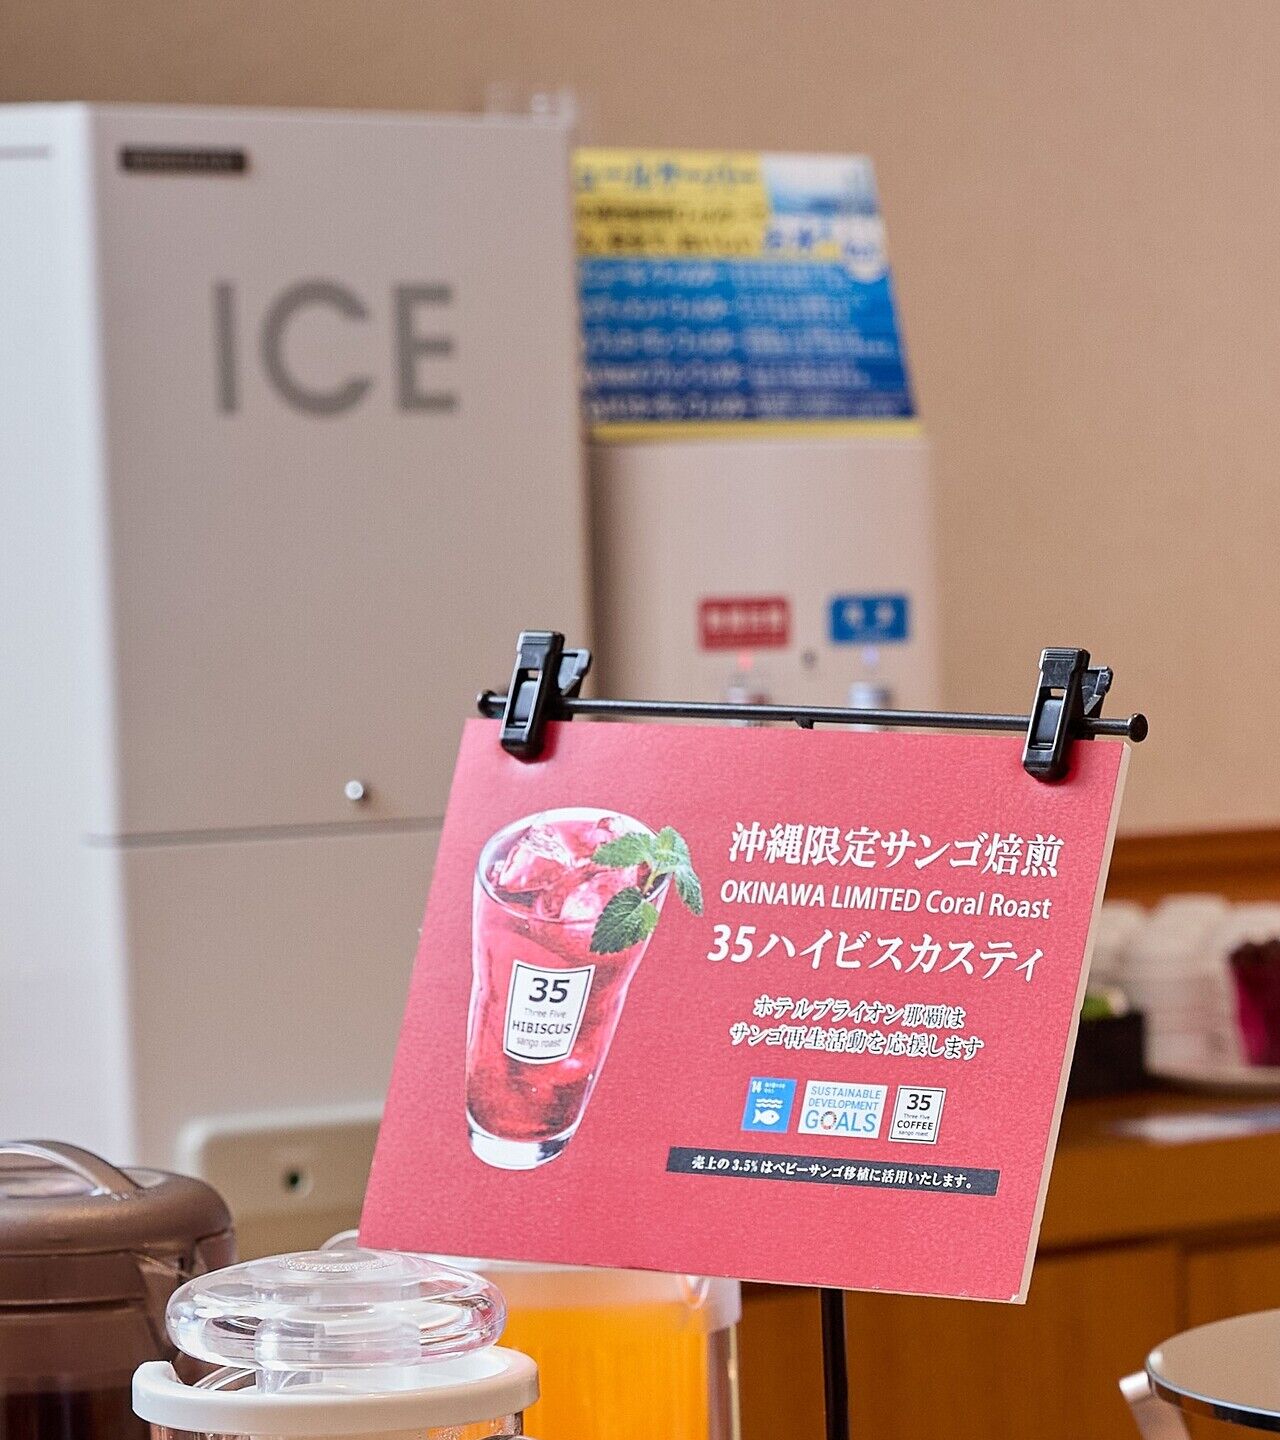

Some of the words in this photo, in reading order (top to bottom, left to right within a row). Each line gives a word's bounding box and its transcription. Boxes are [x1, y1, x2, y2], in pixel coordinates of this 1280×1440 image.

[212, 276, 460, 416] ICE
[729, 821, 1065, 878] 沖縄限定サンゴ焙煎
[720, 879, 826, 908] OKINAWA
[831, 886, 921, 912] LIMITED
[925, 889, 984, 916] Coral
[988, 894, 1053, 920] Roast
[707, 923, 1045, 983] 35ハイビスカスティ
[528, 977, 571, 1004] 35
[549, 1009, 567, 1019] Five
[752, 995, 966, 1029] ホテルブライオン那覇は
[511, 1019, 573, 1035] HIBISCUS
[729, 1021, 985, 1061] サンゴ再生活動を応援します
[808, 1098, 879, 1111] DEVELOPMENT
[810, 1085, 882, 1100] SUSTAINABLE
[906, 1093, 933, 1111] 35
[805, 1109, 878, 1133] GOALS
[896, 1119, 934, 1131] COFFEE
